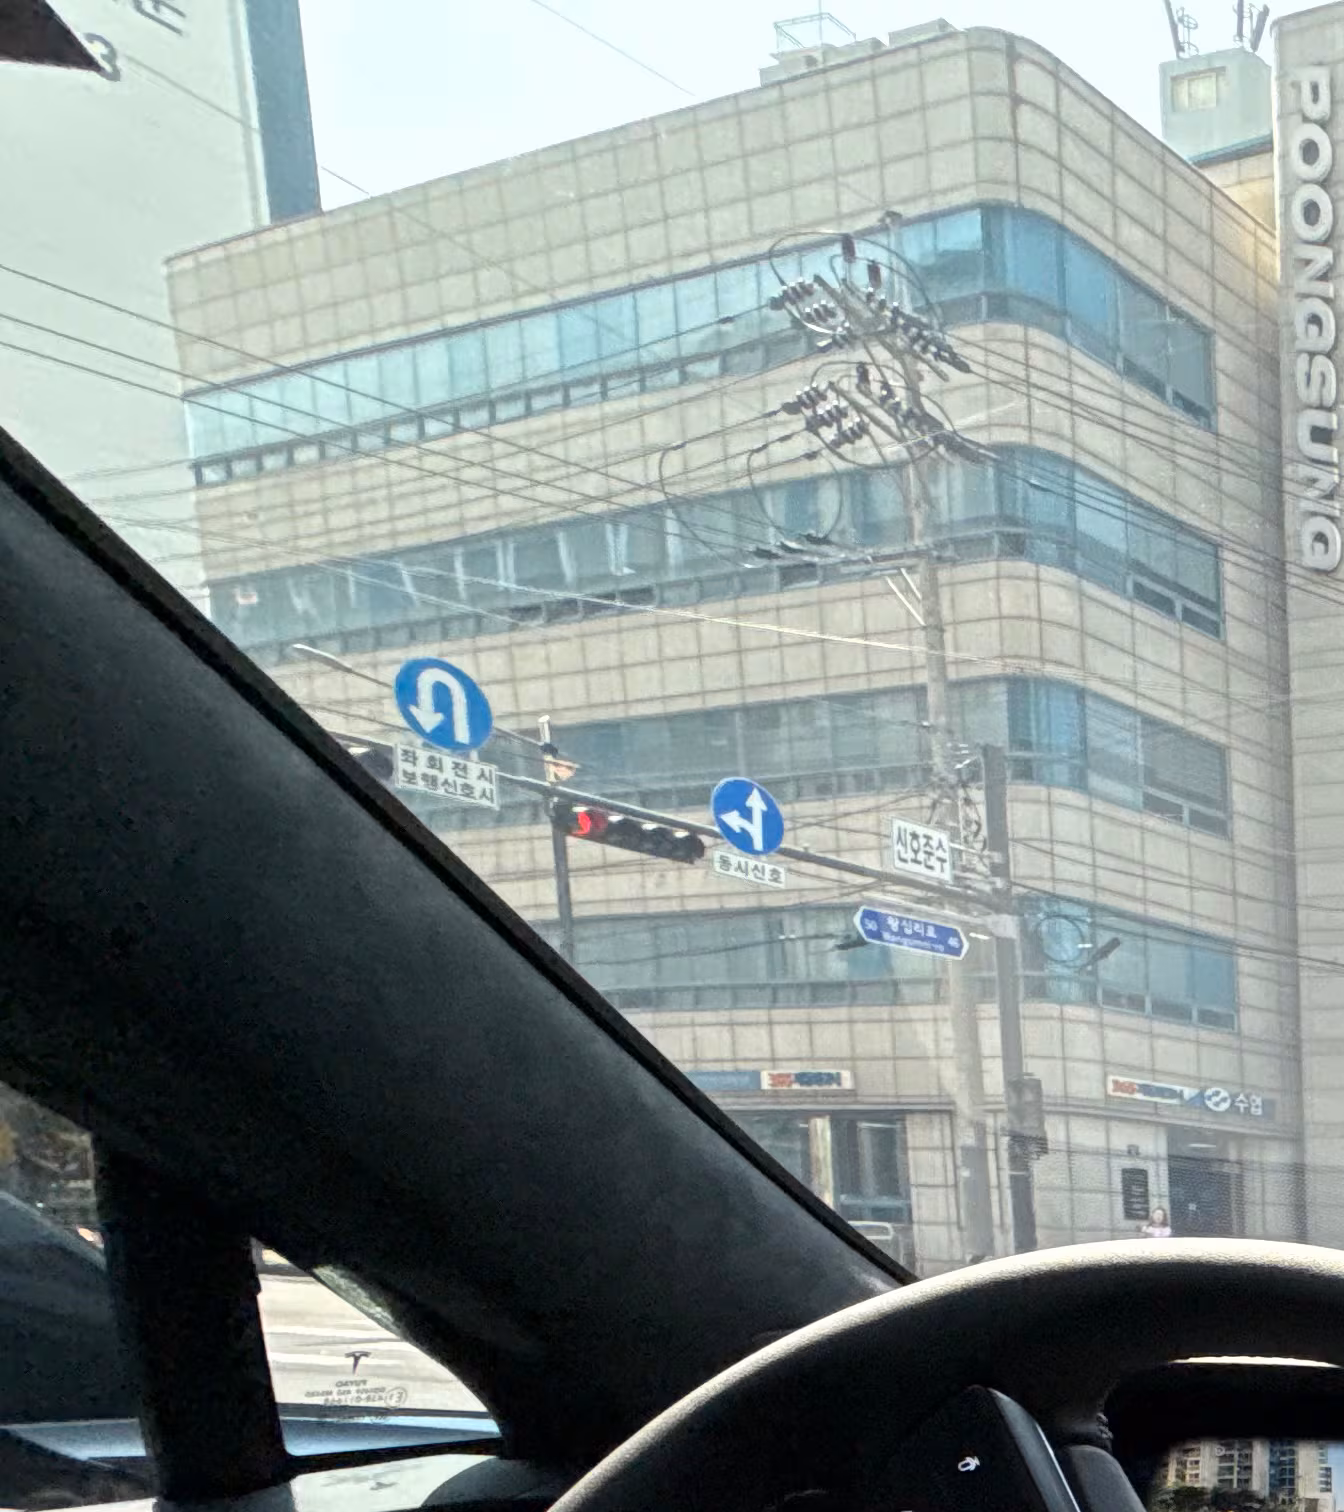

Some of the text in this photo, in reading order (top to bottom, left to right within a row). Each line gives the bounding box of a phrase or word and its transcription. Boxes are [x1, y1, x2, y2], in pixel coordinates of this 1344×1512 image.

[1290, 65, 1342, 573] POONGSUNG
[402, 769, 495, 803] 보행신호시
[896, 826, 948, 873] 신호준수
[719, 854, 784, 885] 동시신호
[886, 916, 938, 938] 왕십리로
[1234, 1092, 1264, 1116] 수협
